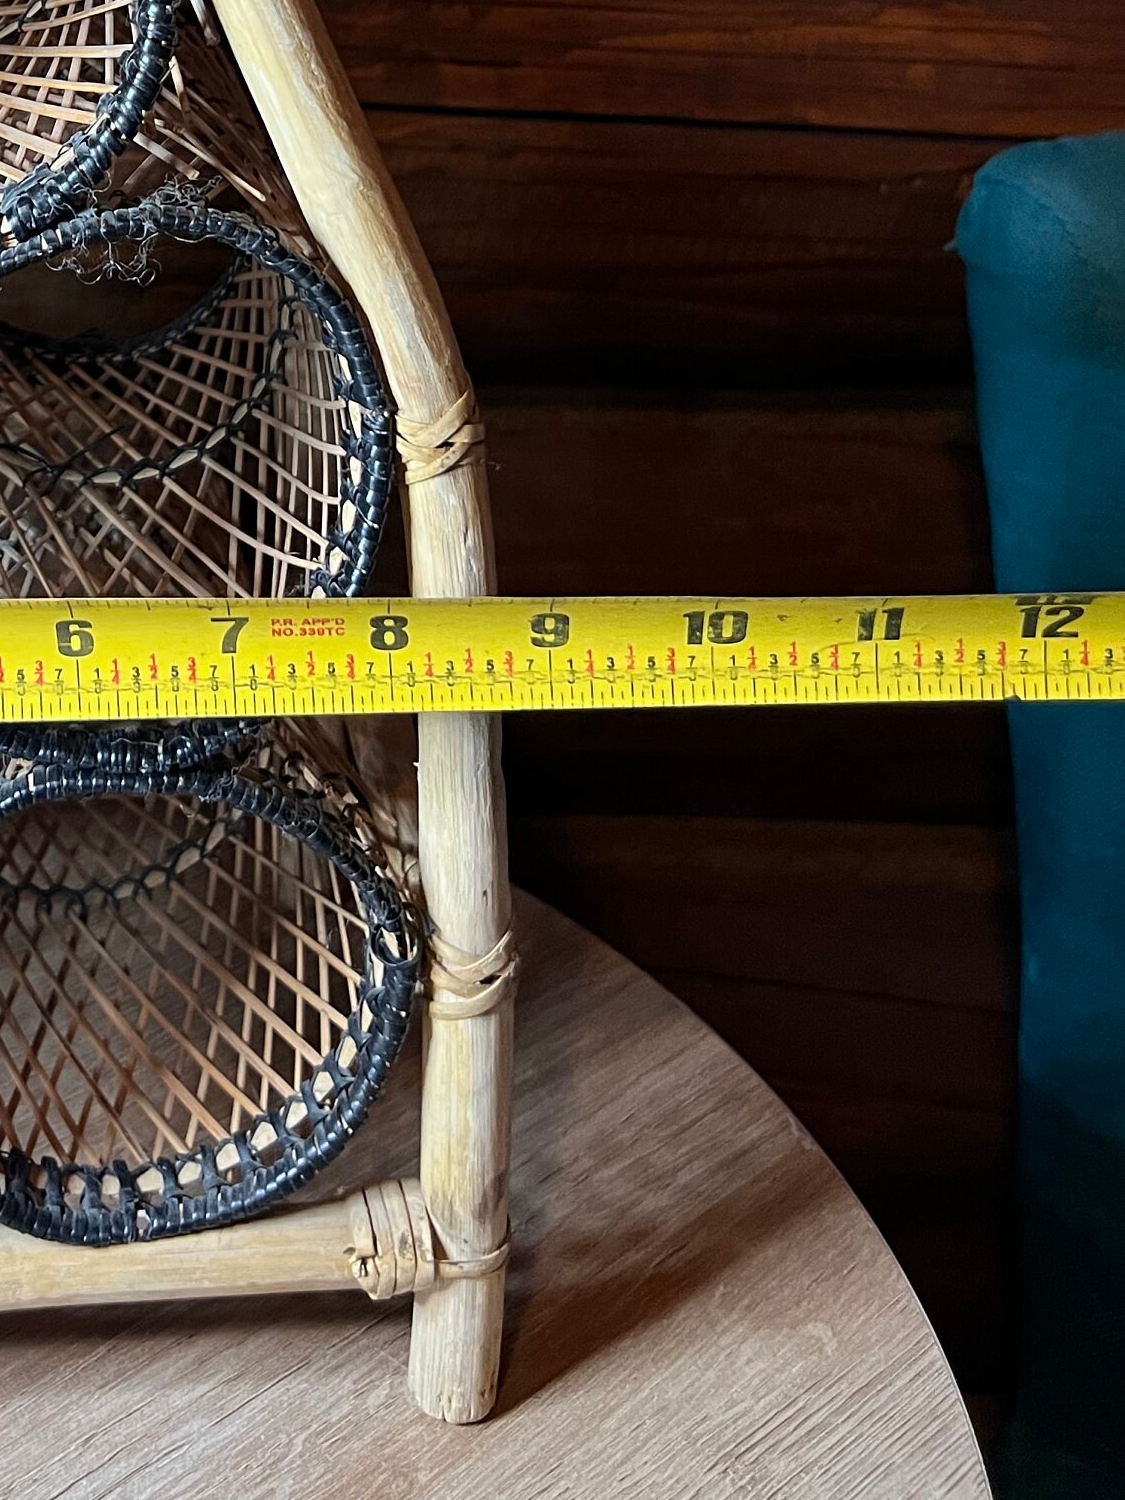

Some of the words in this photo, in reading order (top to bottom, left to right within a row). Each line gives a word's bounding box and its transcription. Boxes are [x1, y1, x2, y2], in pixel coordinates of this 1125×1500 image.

[55, 619, 95, 657] 6
[210, 616, 249, 654] 7
[370, 615, 408, 651] 8
[530, 613, 570, 648] 9
[683, 610, 749, 645] 10
[857, 607, 905, 641] 11
[1019, 605, 1085, 639] 12
